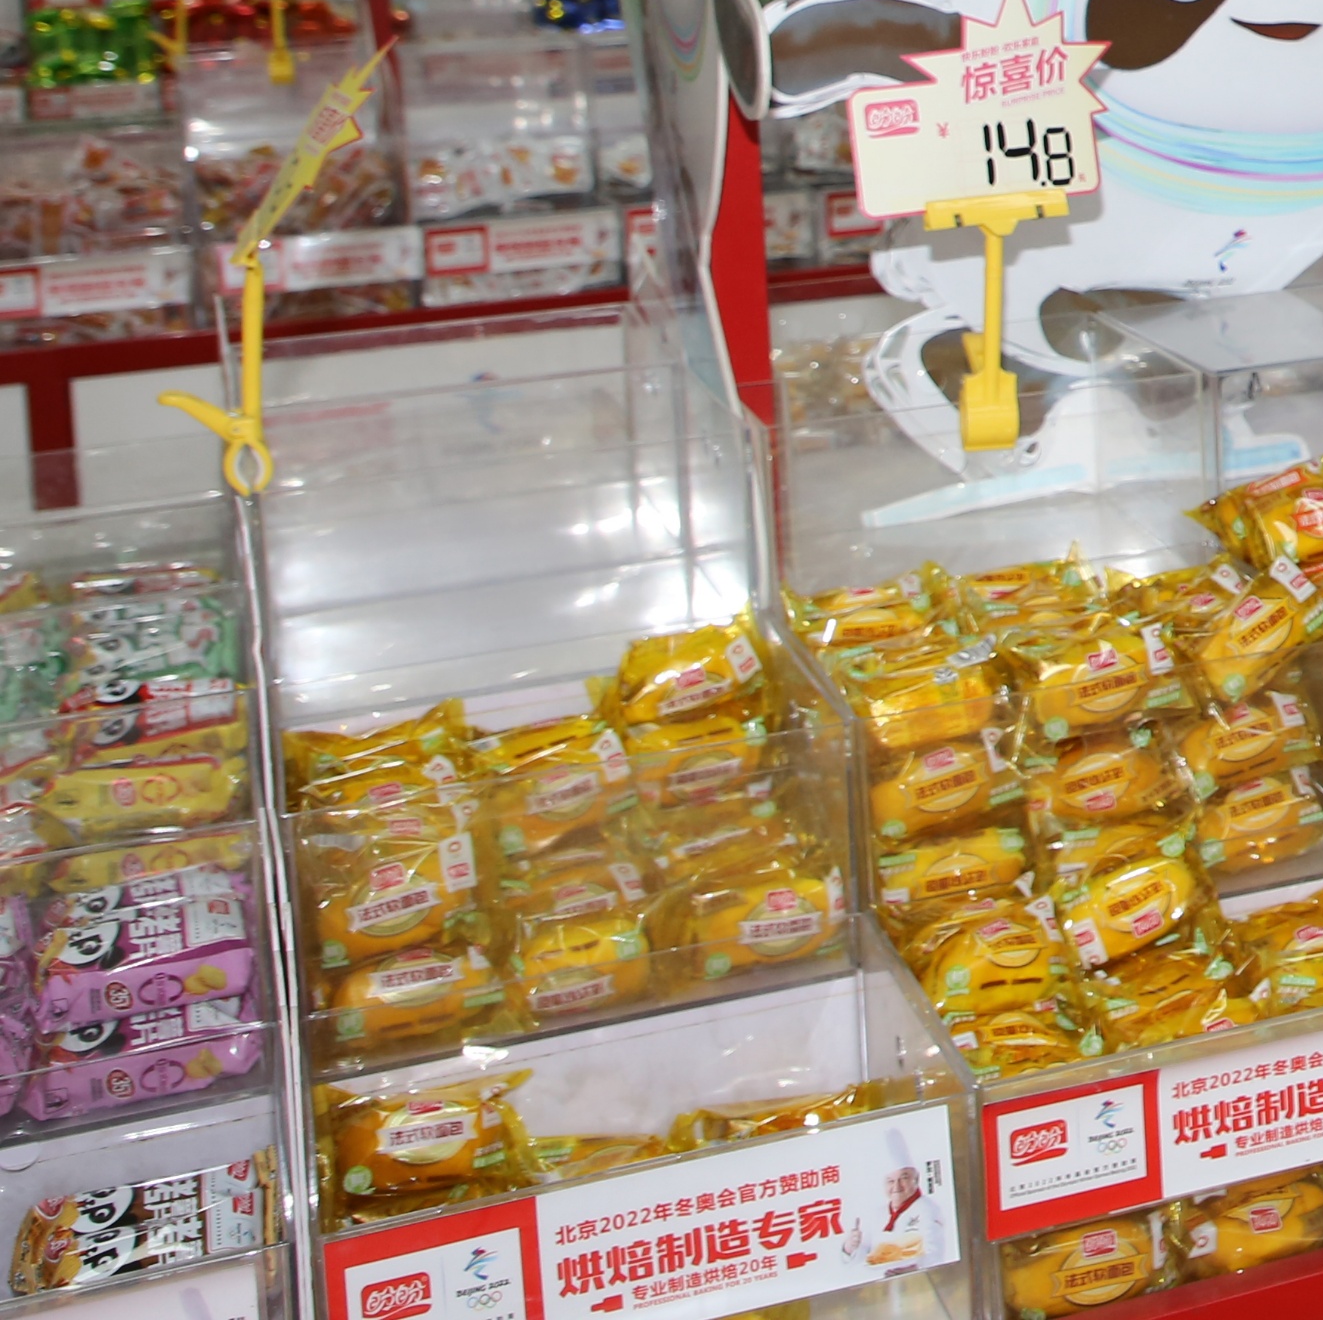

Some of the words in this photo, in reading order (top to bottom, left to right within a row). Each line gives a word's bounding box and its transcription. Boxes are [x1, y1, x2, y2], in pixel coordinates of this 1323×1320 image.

[961, 46, 1069, 104] 惊喜价
[555, 1165, 841, 1246] 北京2022年冬奥会官方赞助商
[557, 1197, 845, 1299] 烘焙制造专家
[364, 1280, 427, 1315] 盼盼
[456, 1285, 487, 1298] BEIJING
[489, 1279, 511, 1289] 2022
[632, 1254, 778, 1301] 专业制造烘焙20年
[633, 1292, 691, 1310] PROFESSIONAL
[693, 1284, 724, 1298] BAKING
[725, 1280, 741, 1290] FOR
[754, 1271, 778, 1284] YEARS
